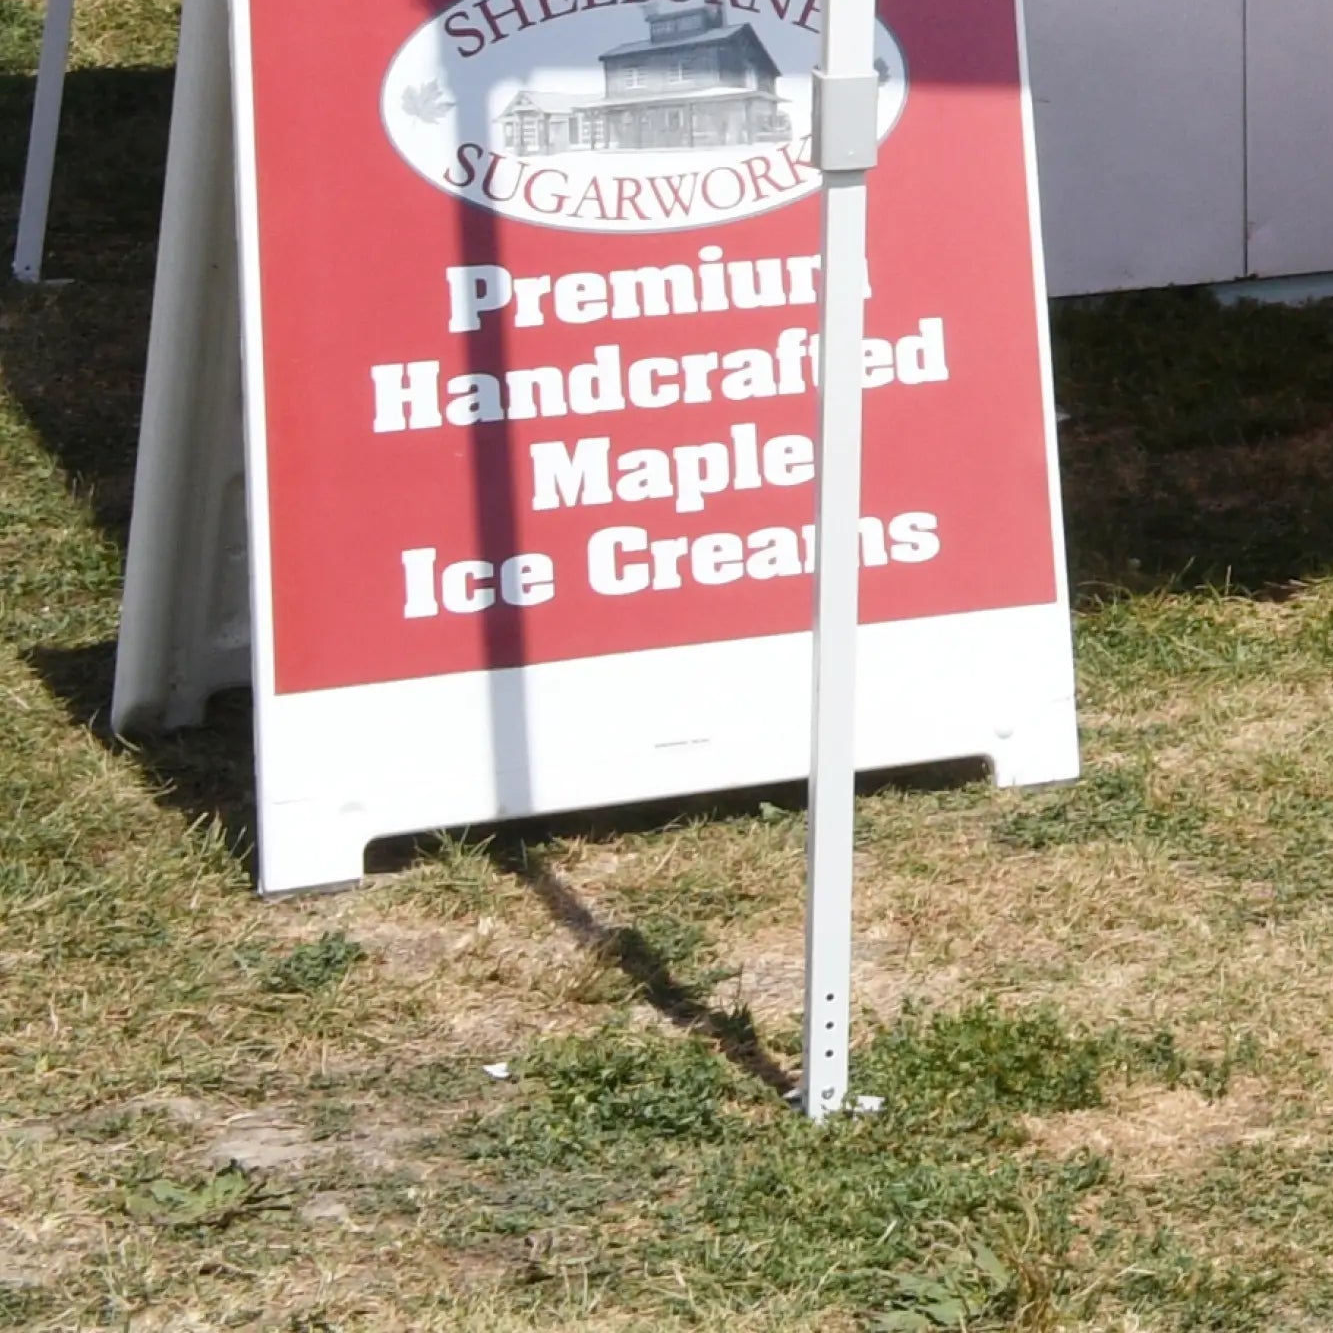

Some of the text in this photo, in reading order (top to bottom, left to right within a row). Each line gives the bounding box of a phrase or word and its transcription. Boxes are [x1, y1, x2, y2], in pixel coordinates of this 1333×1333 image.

[443, 134, 817, 222] SUGARWORK
[530, 422, 815, 513] Maple
[402, 547, 555, 619] Ice
